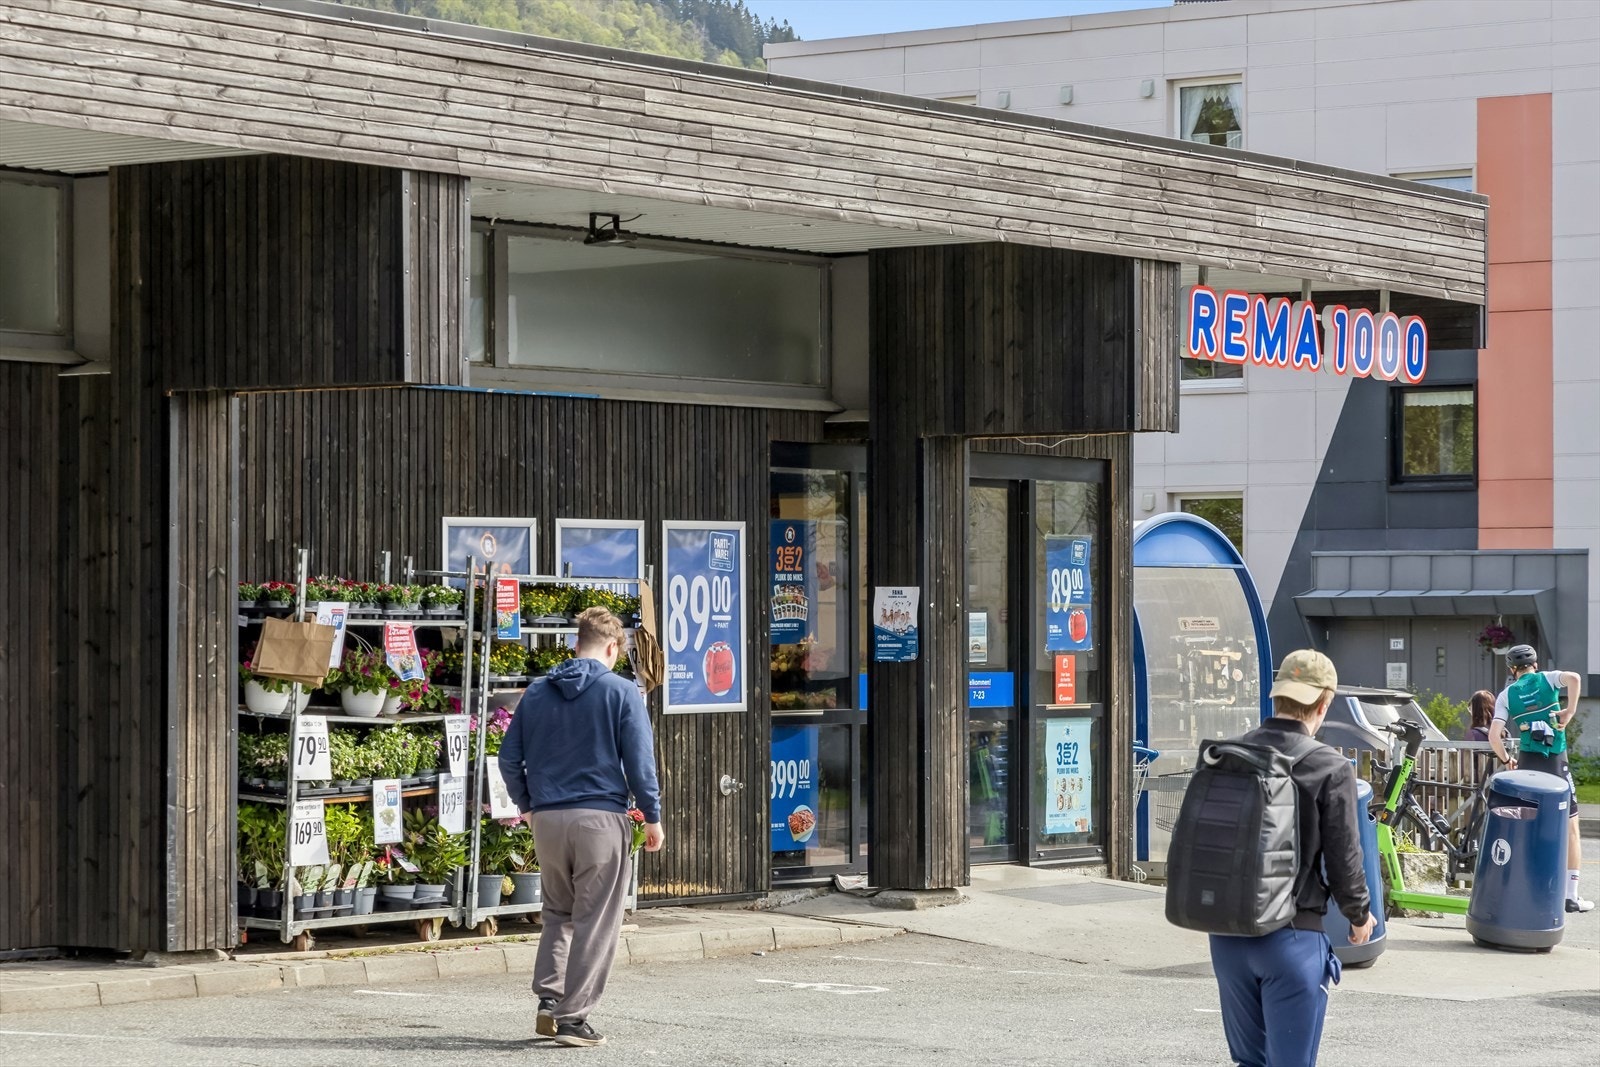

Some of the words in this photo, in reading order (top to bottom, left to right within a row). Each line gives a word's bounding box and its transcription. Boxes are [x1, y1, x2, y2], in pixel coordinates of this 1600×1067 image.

[1189, 285, 1322, 372] REMA
[1332, 304, 1428, 384] 1000
[713, 538, 731, 549] PARTI-
[775, 545, 784, 571] 3
[784, 545, 795, 571] FOR
[795, 546, 803, 571] 2
[1051, 568, 1072, 613] 89
[1072, 569, 1084, 590] 00
[668, 574, 711, 653] 89
[711, 575, 731, 613] 00
[969, 678, 992, 686] elkommen!
[972, 690, 985, 700] 7-23
[298, 736, 317, 766] 79
[317, 737, 327, 751] 90
[449, 735, 462, 762] 49
[1056, 742, 1063, 766] 3
[1063, 742, 1072, 765] FOR
[1072, 742, 1079, 765] 2
[798, 759, 810, 779] 00
[441, 792, 457, 815] 199
[294, 821, 312, 846] 169
[312, 821, 323, 834] 90
